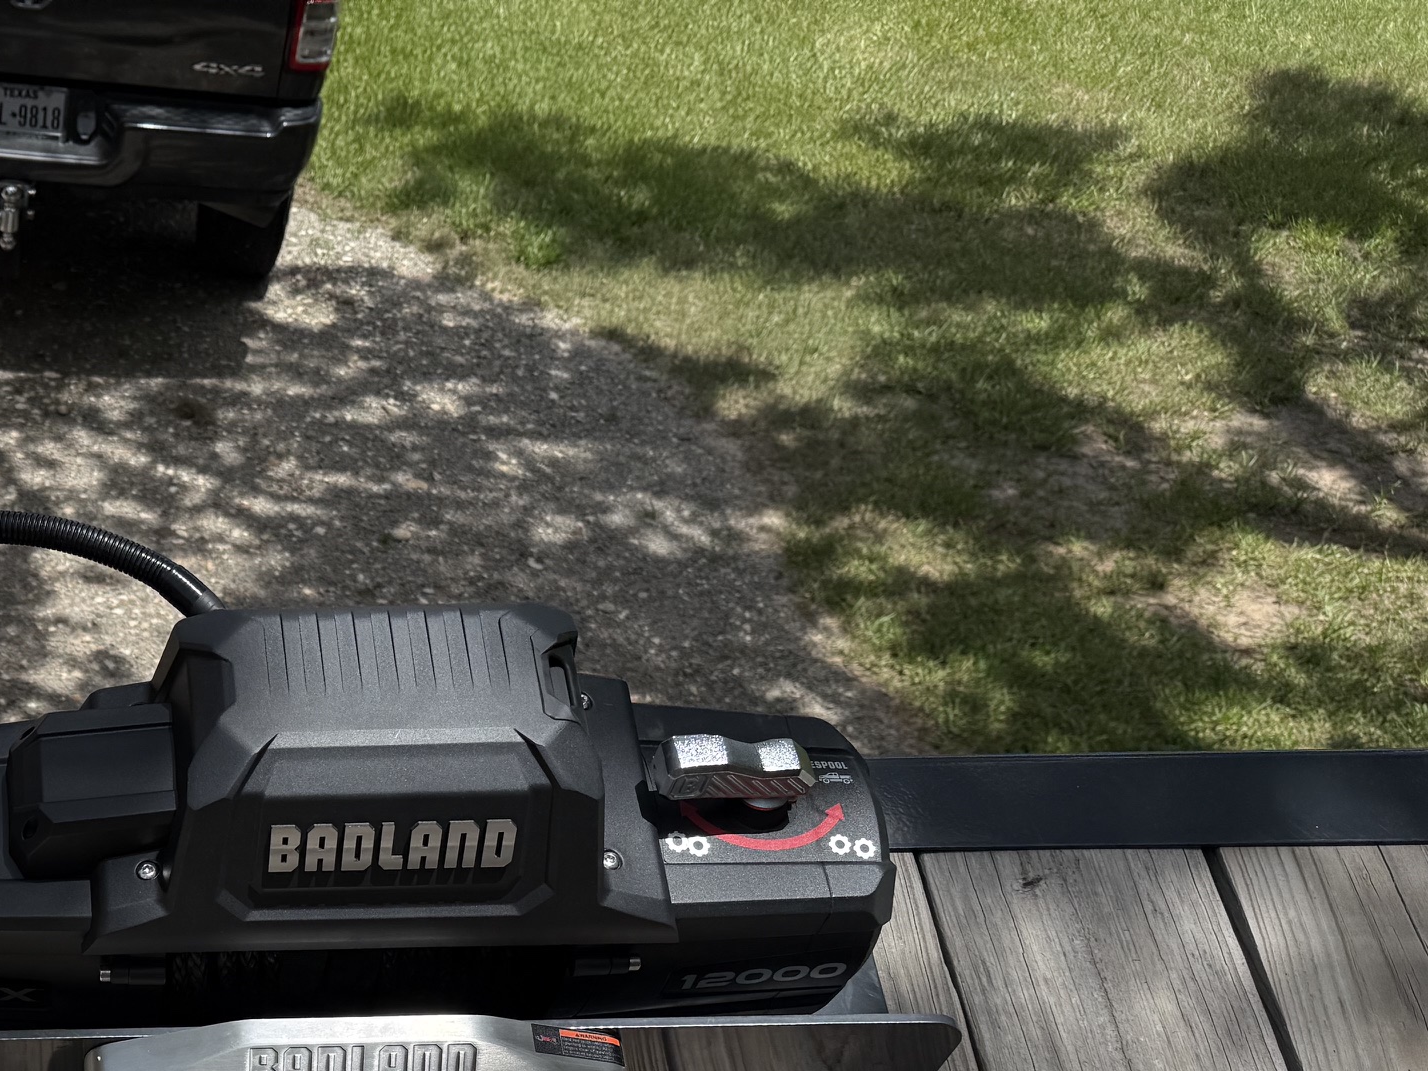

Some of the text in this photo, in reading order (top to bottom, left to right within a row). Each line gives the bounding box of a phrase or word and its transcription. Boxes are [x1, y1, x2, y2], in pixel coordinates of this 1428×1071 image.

[3, 87, 39, 100] TEXAS
[268, 819, 517, 873] BADLAND
[680, 962, 848, 990] 12000
